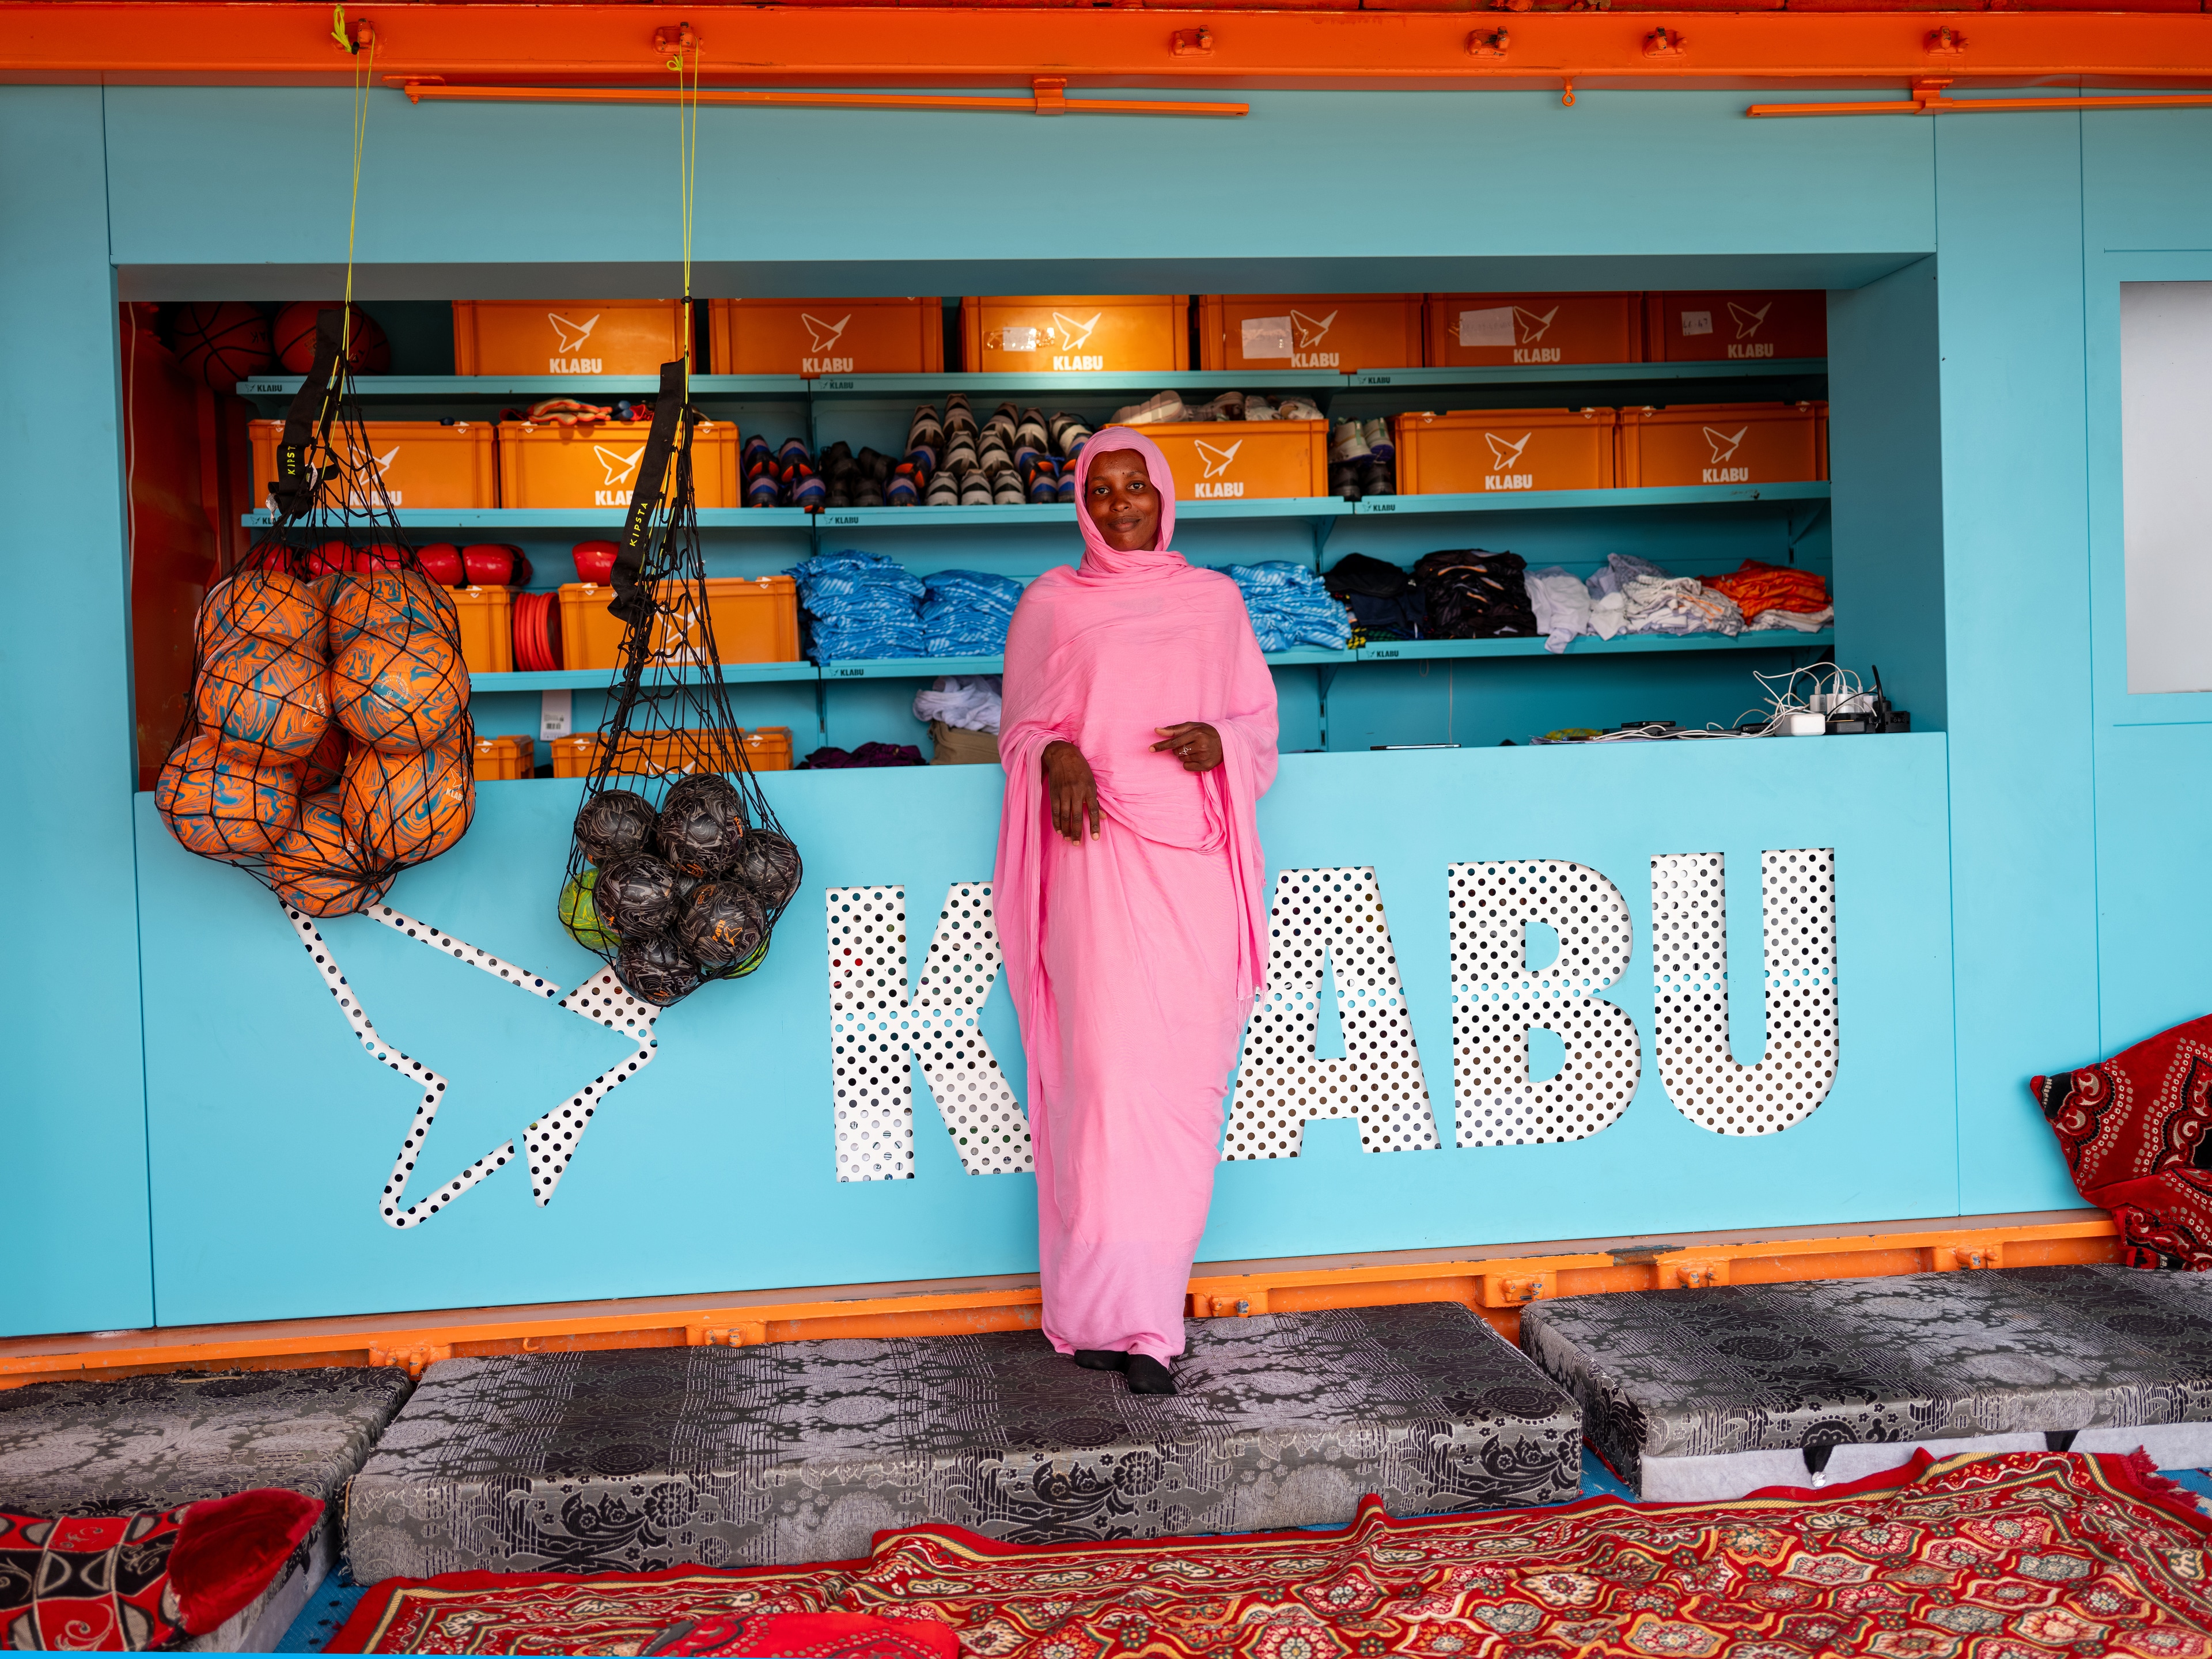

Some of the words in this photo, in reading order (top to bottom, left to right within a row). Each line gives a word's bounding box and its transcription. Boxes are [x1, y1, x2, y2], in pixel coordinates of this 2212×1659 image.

[1513, 348, 1560, 362] KLABU
[1728, 343, 1774, 358] KLABU
[549, 358, 602, 374] KLABU
[802, 358, 853, 373] KLABU
[1053, 355, 1103, 370] KLABU
[1291, 353, 1339, 368] KLABU
[287, 445, 296, 475] KIPST
[1485, 474, 1532, 490] KLABU
[1703, 467, 1748, 483] KLABU
[595, 490, 634, 506] KLAB
[1195, 482, 1244, 498] KLABU
[629, 503, 648, 547] KIPSTA
[826, 848, 1839, 1182] KABU
